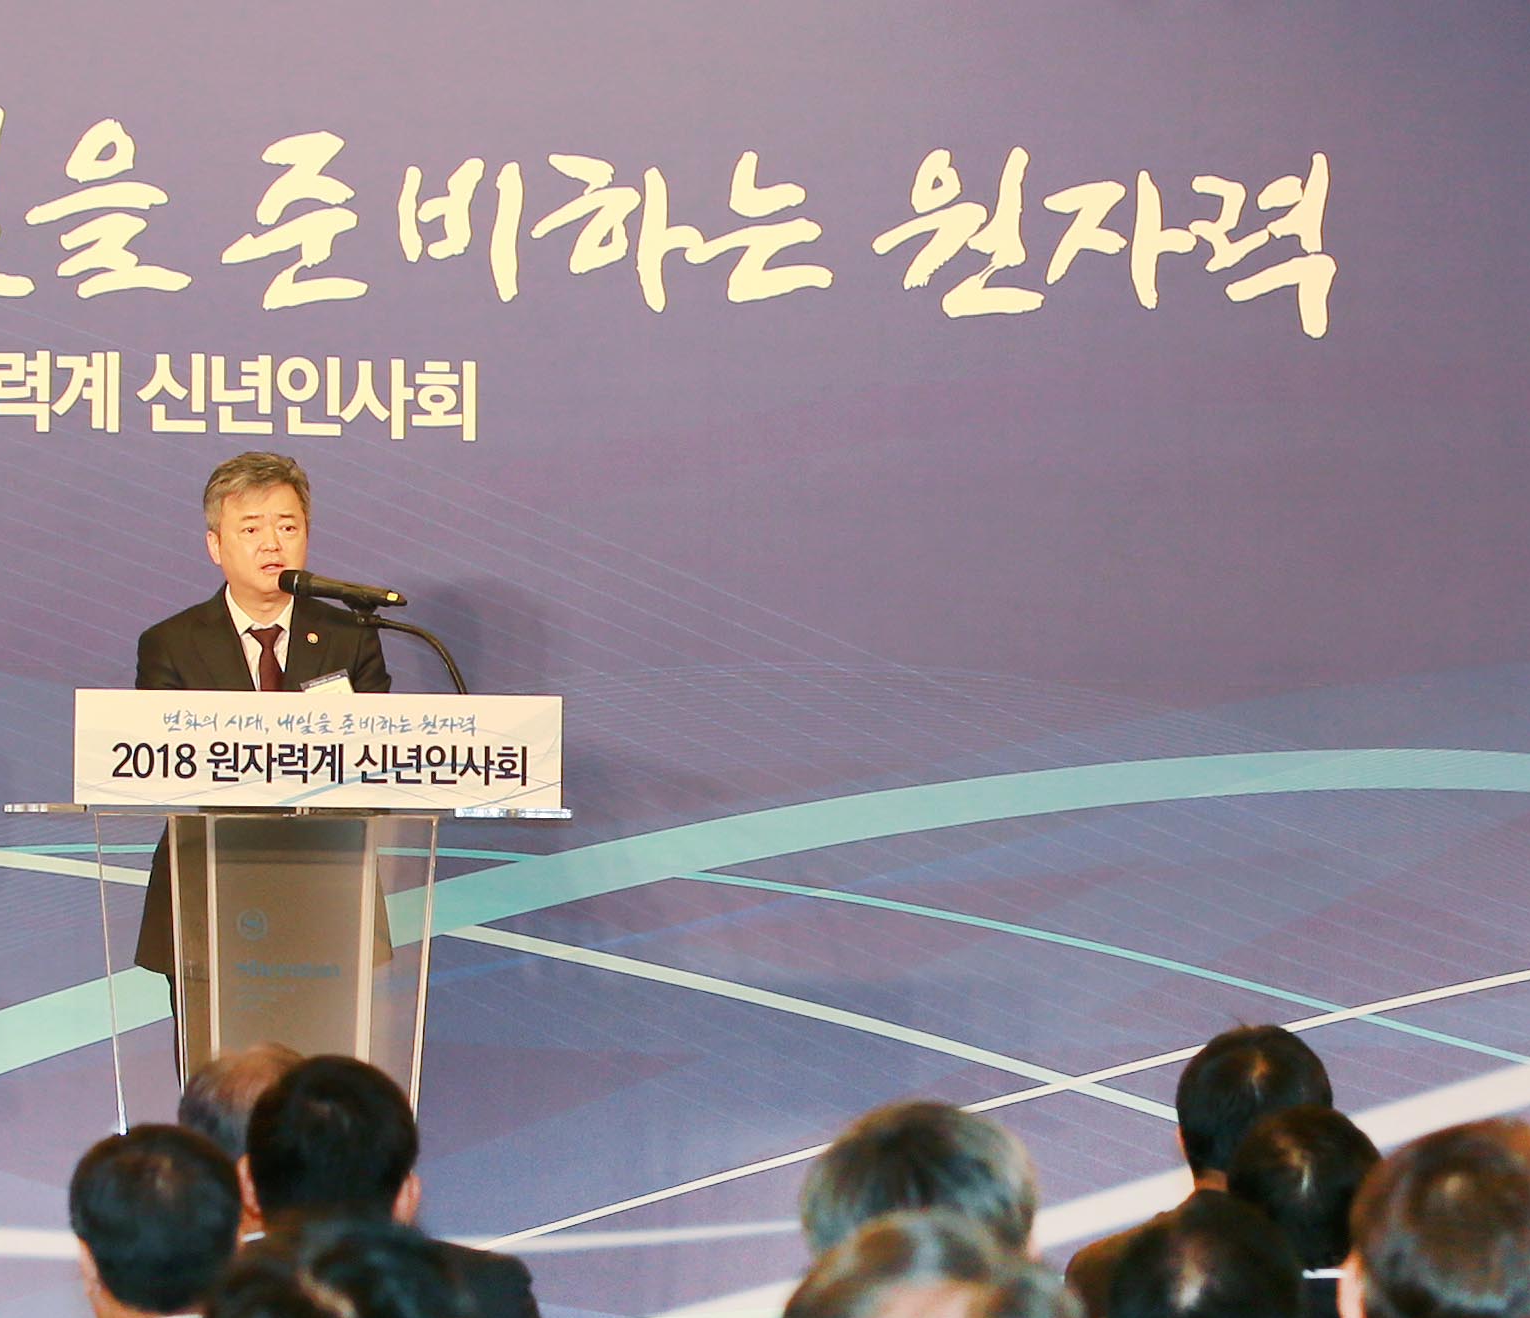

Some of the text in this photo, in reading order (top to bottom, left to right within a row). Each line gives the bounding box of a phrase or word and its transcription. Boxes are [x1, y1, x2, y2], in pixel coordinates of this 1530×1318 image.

[872, 146, 1337, 338] 원자력
[135, 352, 477, 441] 신년인사회
[163, 709, 218, 733] 변화의
[224, 712, 270, 735] 시대,
[276, 711, 335, 735] 내일을
[417, 714, 478, 737] 원자력
[111, 741, 528, 786] 2018 원자력계 신년인사회
